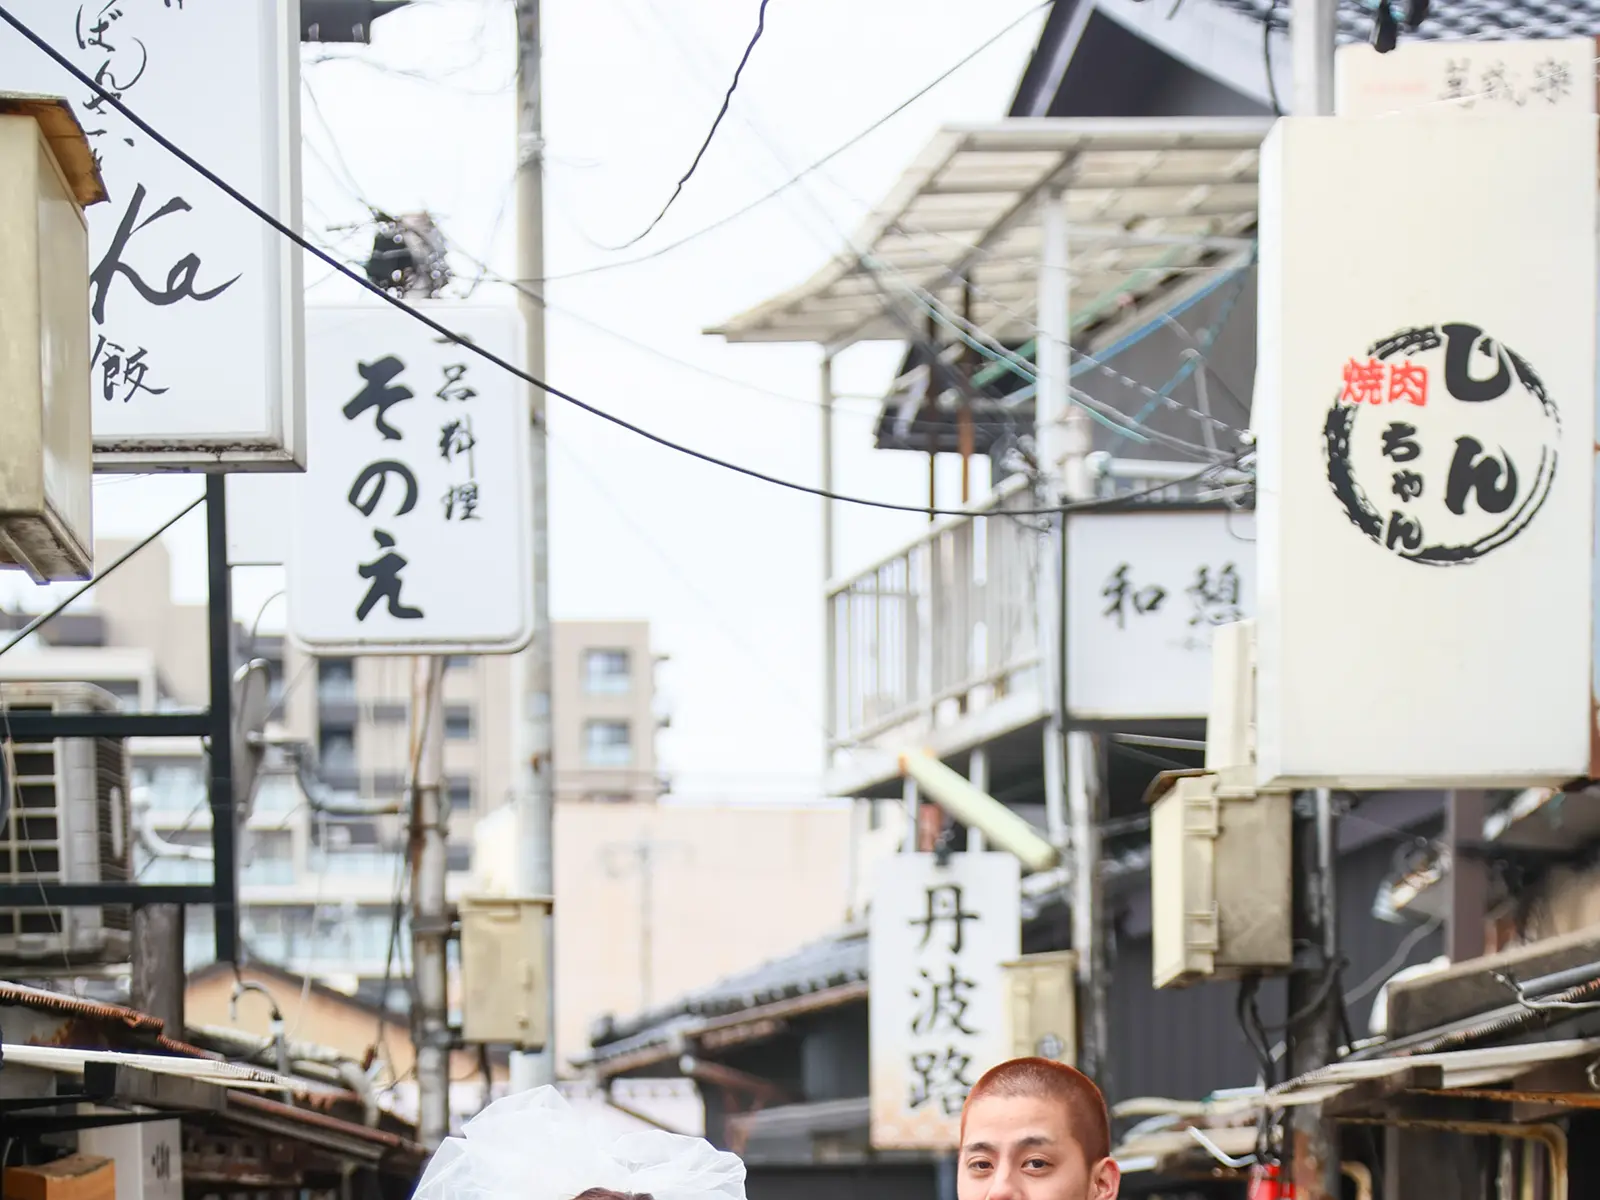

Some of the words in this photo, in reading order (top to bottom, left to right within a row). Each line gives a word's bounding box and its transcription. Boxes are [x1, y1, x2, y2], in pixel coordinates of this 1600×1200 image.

[91, 334, 170, 403] 飯
[1340, 357, 1428, 406] 焼肉
[343, 355, 424, 621] そのえ
[1381, 420, 1422, 550] ちゃん
[908, 883, 979, 1114] 丹波路
